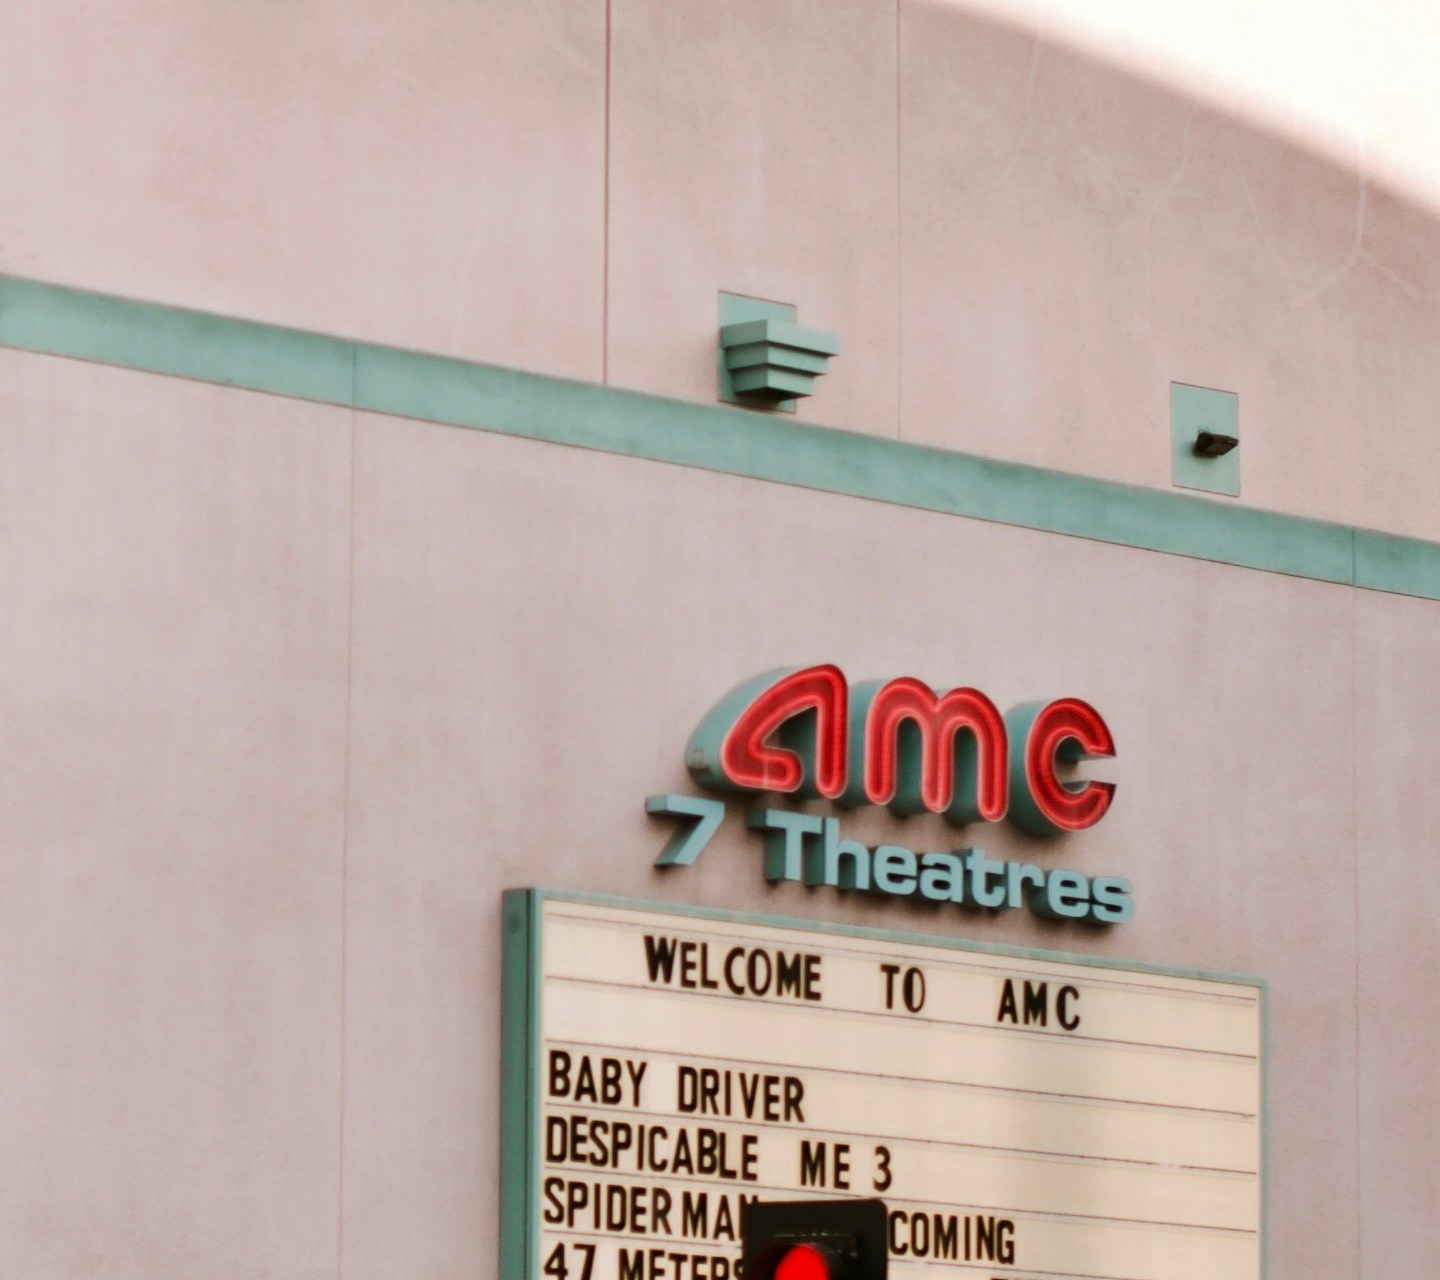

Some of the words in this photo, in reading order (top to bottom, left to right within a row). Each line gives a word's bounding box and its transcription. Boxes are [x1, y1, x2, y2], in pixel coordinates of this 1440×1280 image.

[646, 793, 726, 867] 7
[760, 807, 1137, 924] Theatres
[643, 934, 822, 1002] WELCOME
[880, 963, 926, 1014] TO
[997, 978, 1081, 1032] AMC
[548, 1049, 648, 1108] BABY
[677, 1065, 806, 1123] DRIVER
[545, 1114, 759, 1182] DESPICABLE
[800, 1140, 850, 1191] ME
[873, 1145, 893, 1193] 3
